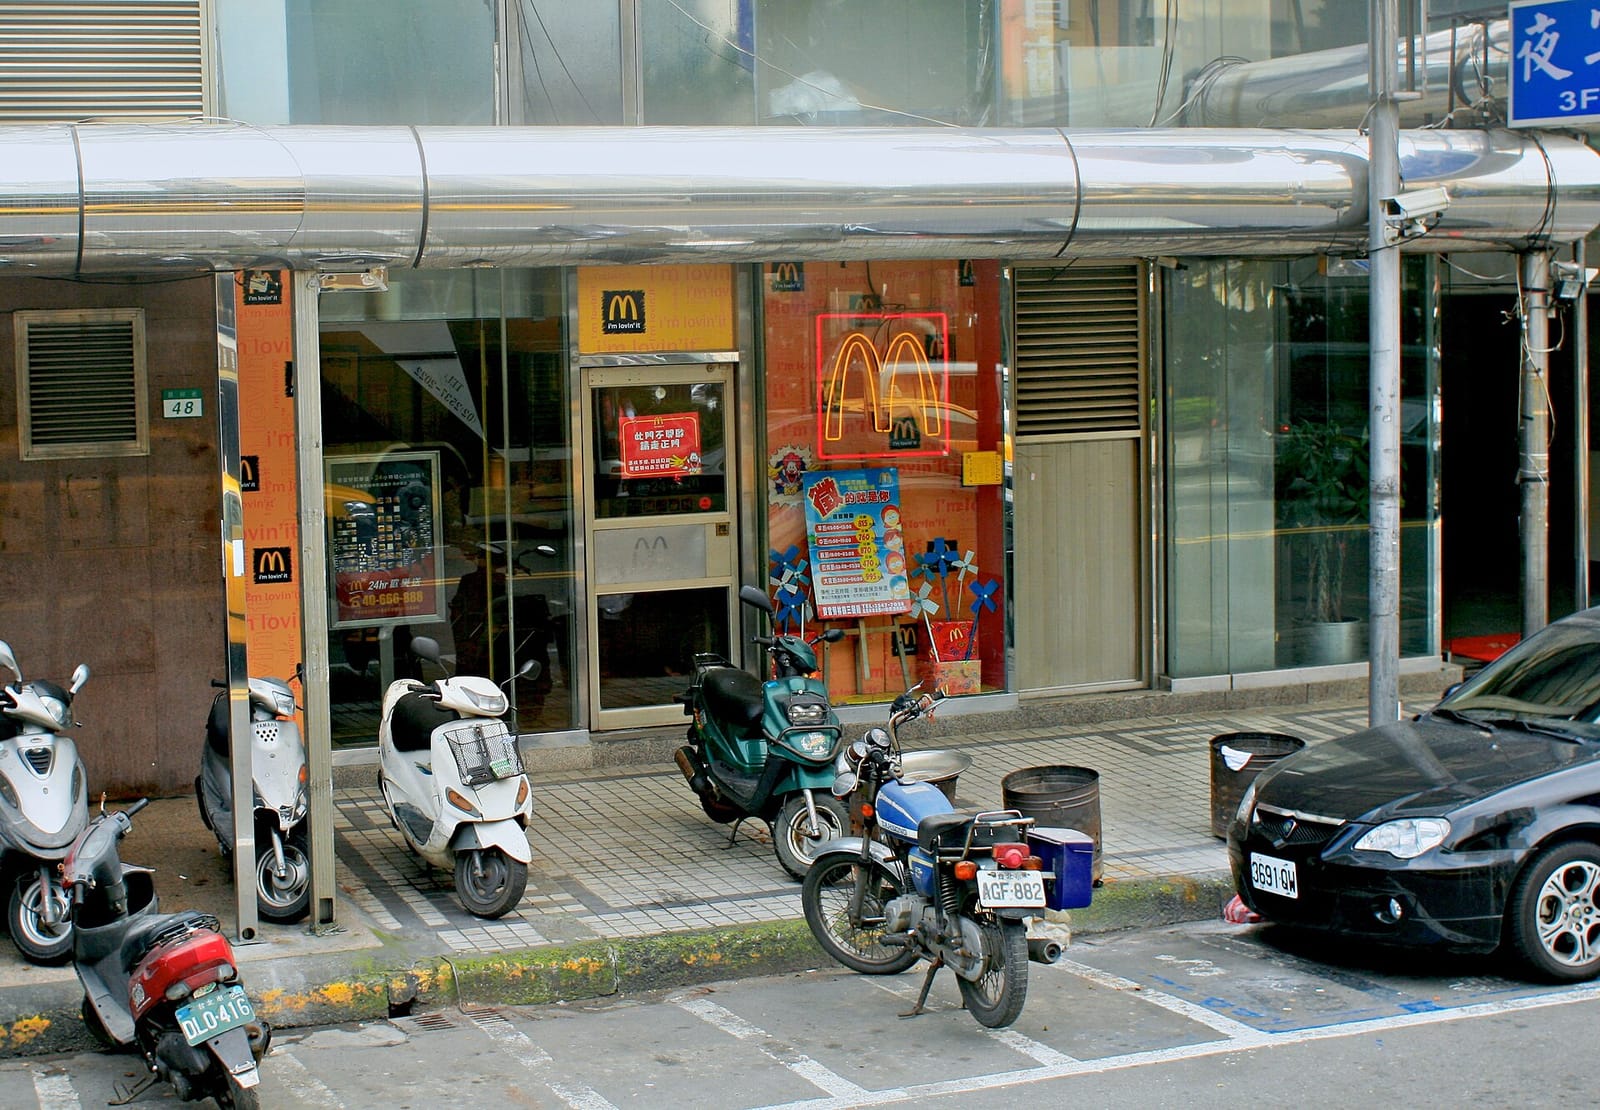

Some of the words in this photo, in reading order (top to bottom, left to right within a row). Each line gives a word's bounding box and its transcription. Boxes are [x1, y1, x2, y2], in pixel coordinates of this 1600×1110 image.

[1559, 88, 1600, 111] 3F
[172, 401, 194, 415] 48
[367, 580, 388, 591] 24hr
